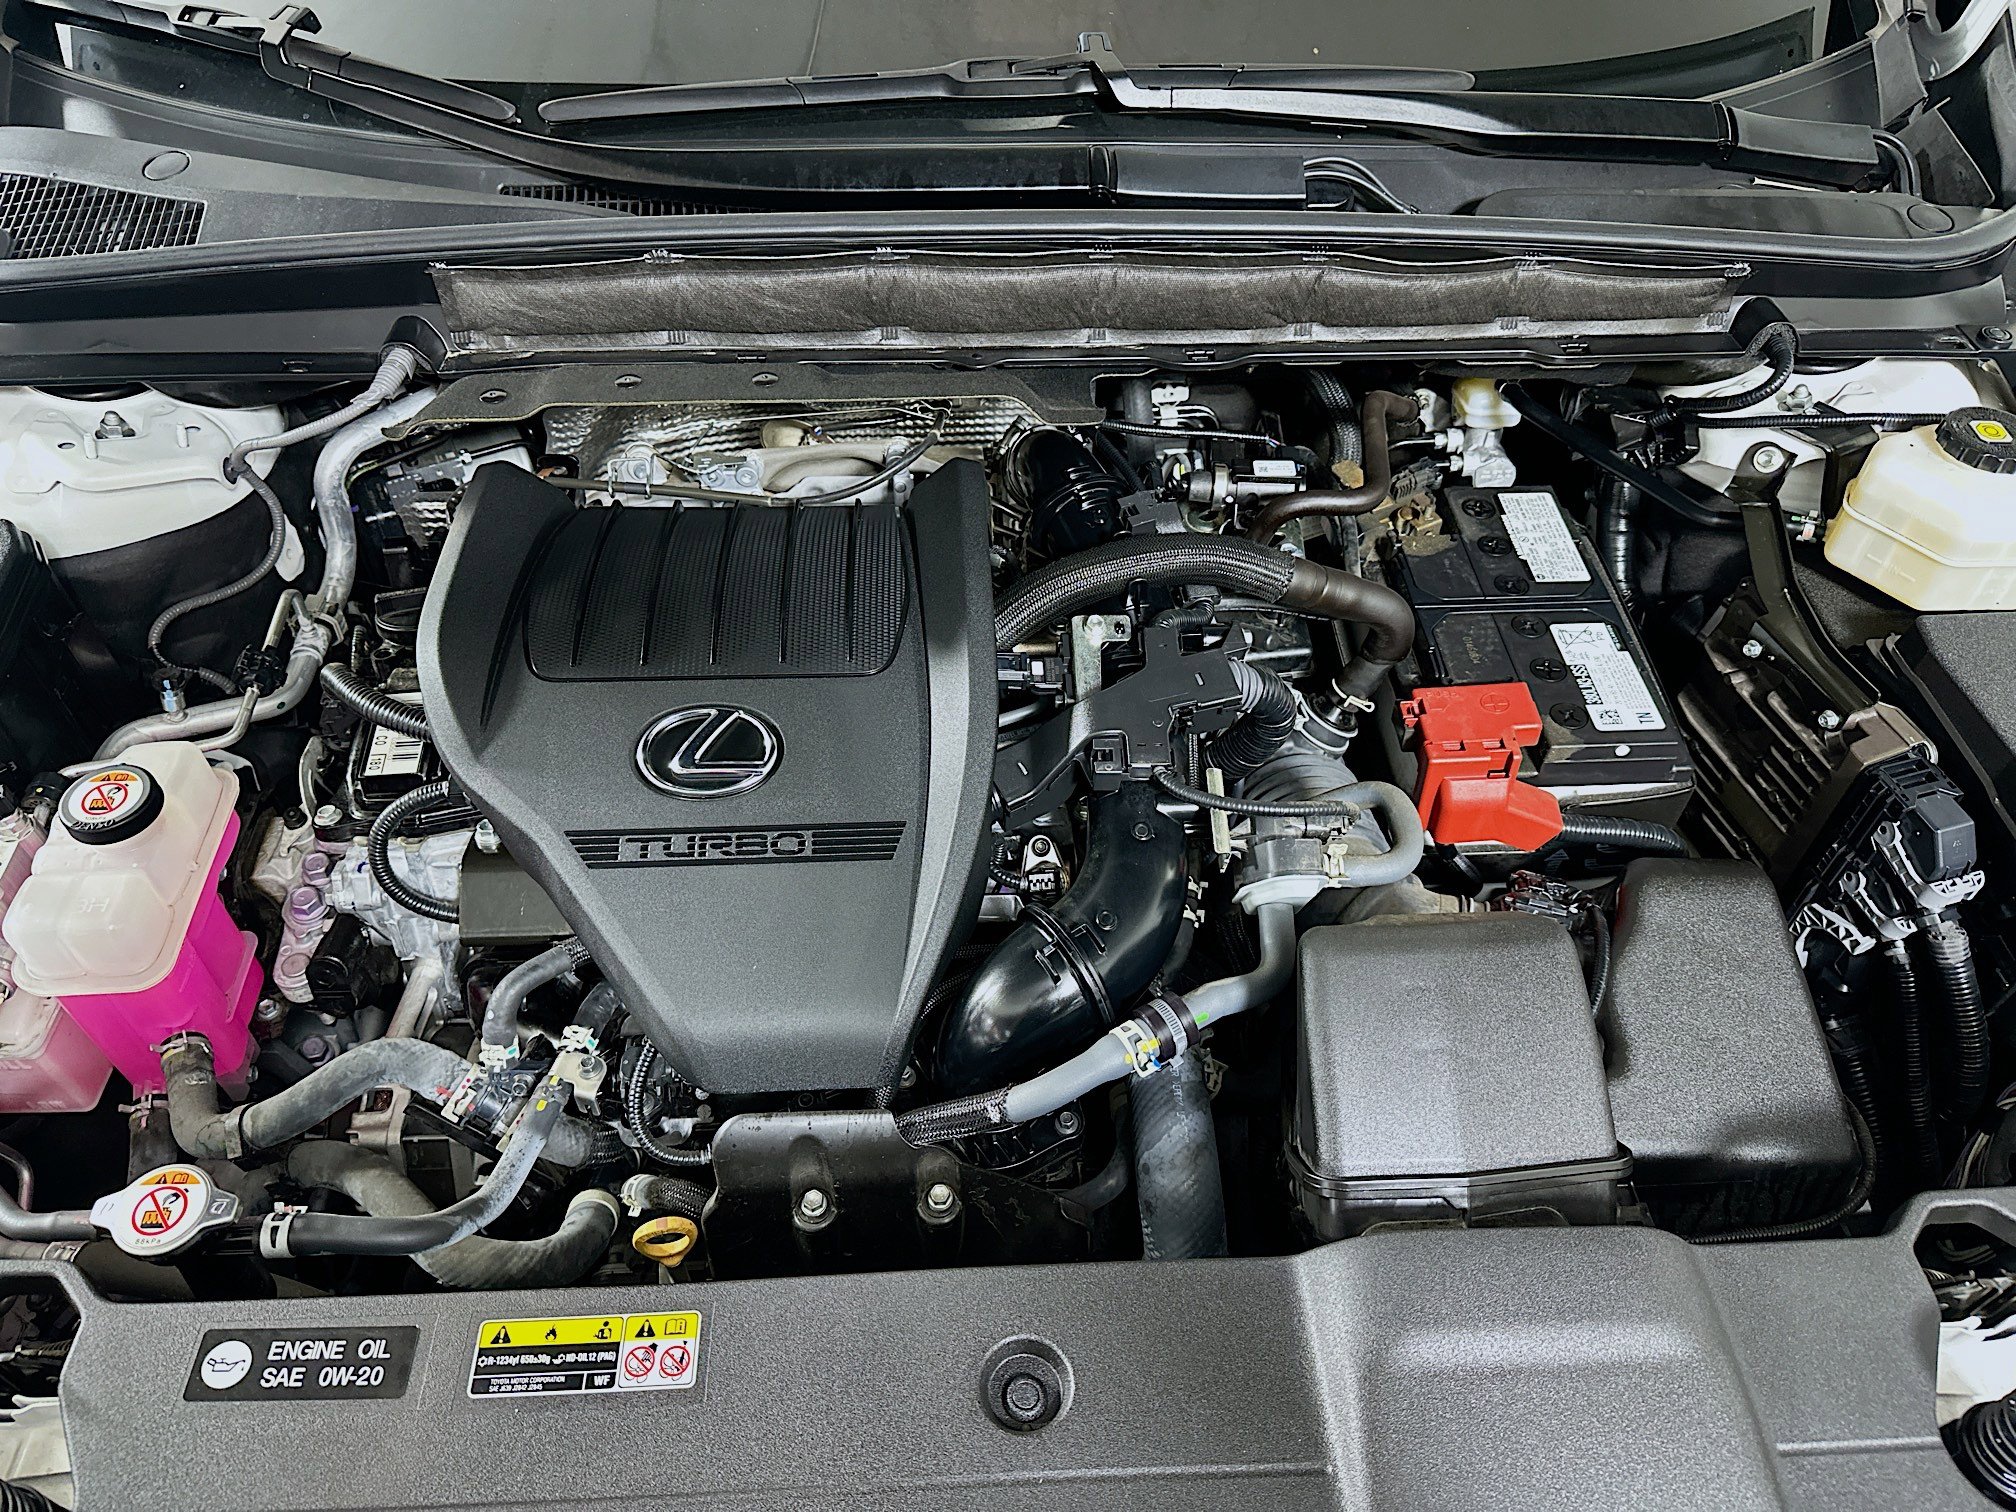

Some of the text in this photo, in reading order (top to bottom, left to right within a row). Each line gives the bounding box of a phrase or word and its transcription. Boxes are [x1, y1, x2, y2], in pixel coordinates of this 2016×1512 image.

[1636, 712, 1655, 724] TN
[625, 832, 806, 858] TURBO
[267, 1339, 391, 1361] ENGINE OIL
[259, 1366, 384, 1388] SAE 0W-20
[593, 1375, 611, 1386] WF
